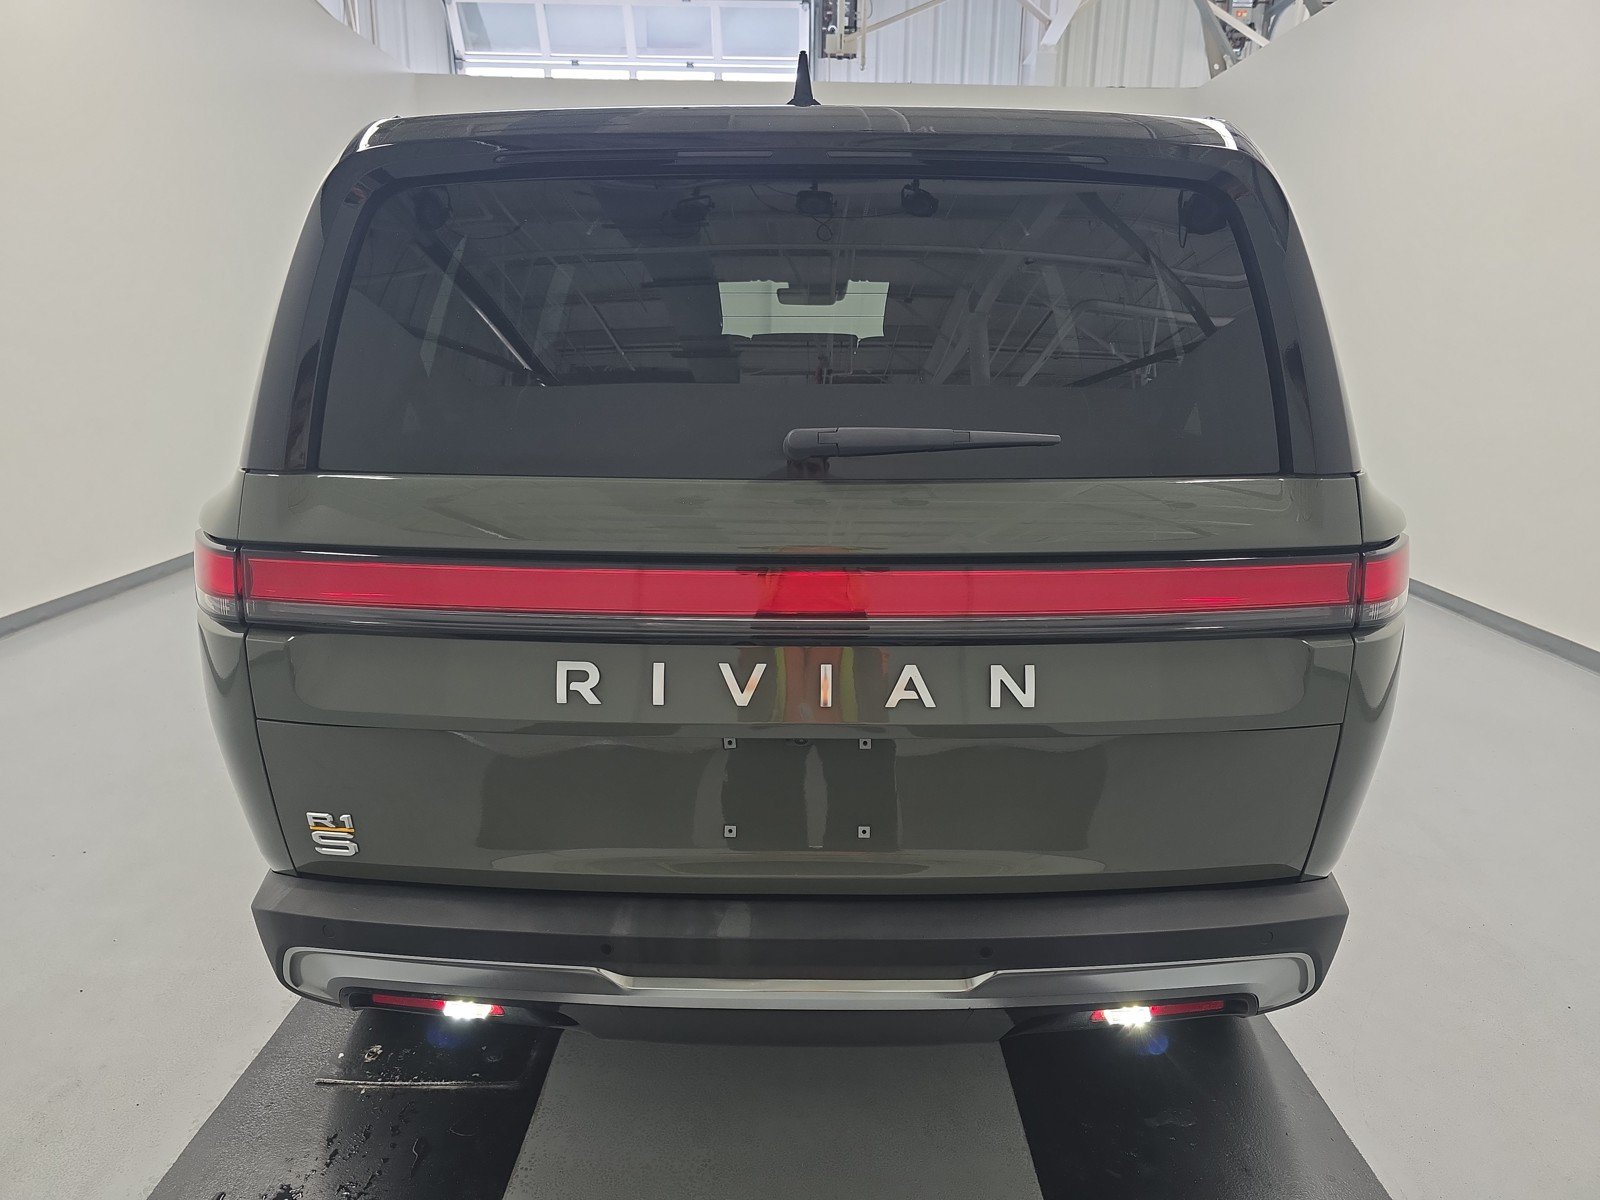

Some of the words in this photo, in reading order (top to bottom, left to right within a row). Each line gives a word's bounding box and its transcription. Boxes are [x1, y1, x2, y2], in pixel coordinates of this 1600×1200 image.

[556, 660, 1036, 708] RIVIAN
[306, 811, 354, 829] R1
[311, 830, 359, 856] S
